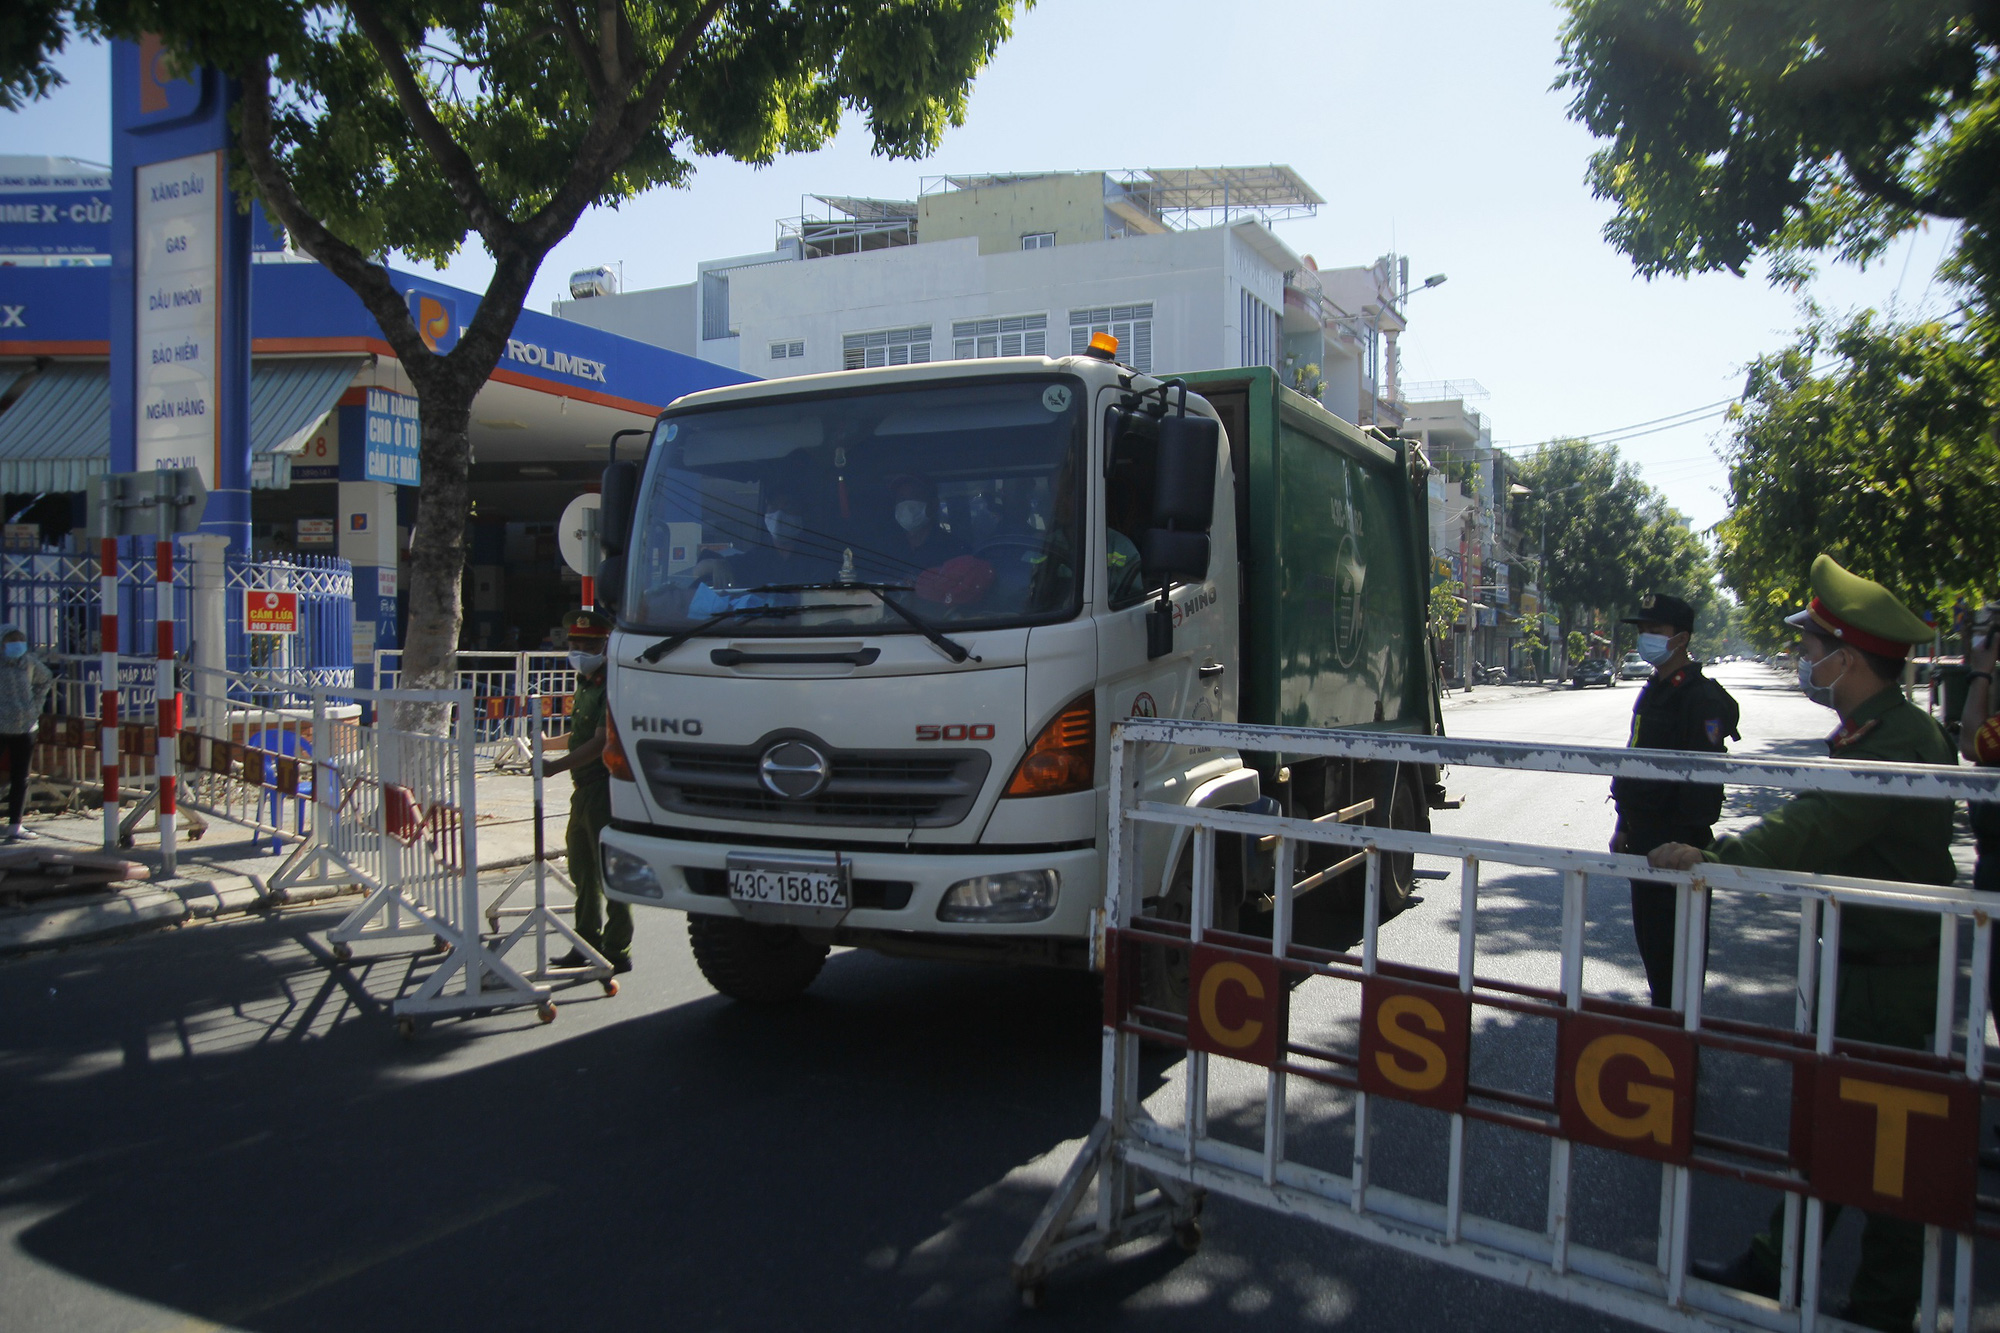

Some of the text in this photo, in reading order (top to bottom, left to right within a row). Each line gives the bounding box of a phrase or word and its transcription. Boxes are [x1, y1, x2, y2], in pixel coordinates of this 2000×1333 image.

[166, 235, 187, 253] GAS
[368, 389, 389, 414] LÀN
[369, 416, 392, 445] CHO
[404, 420, 418, 449] TÔ
[1184, 587, 1217, 618] HINO
[250, 607, 294, 620] CẤM LỬA
[251, 622, 293, 631] NO FIRE
[631, 716, 704, 736] HINO
[915, 723, 996, 741] 500
